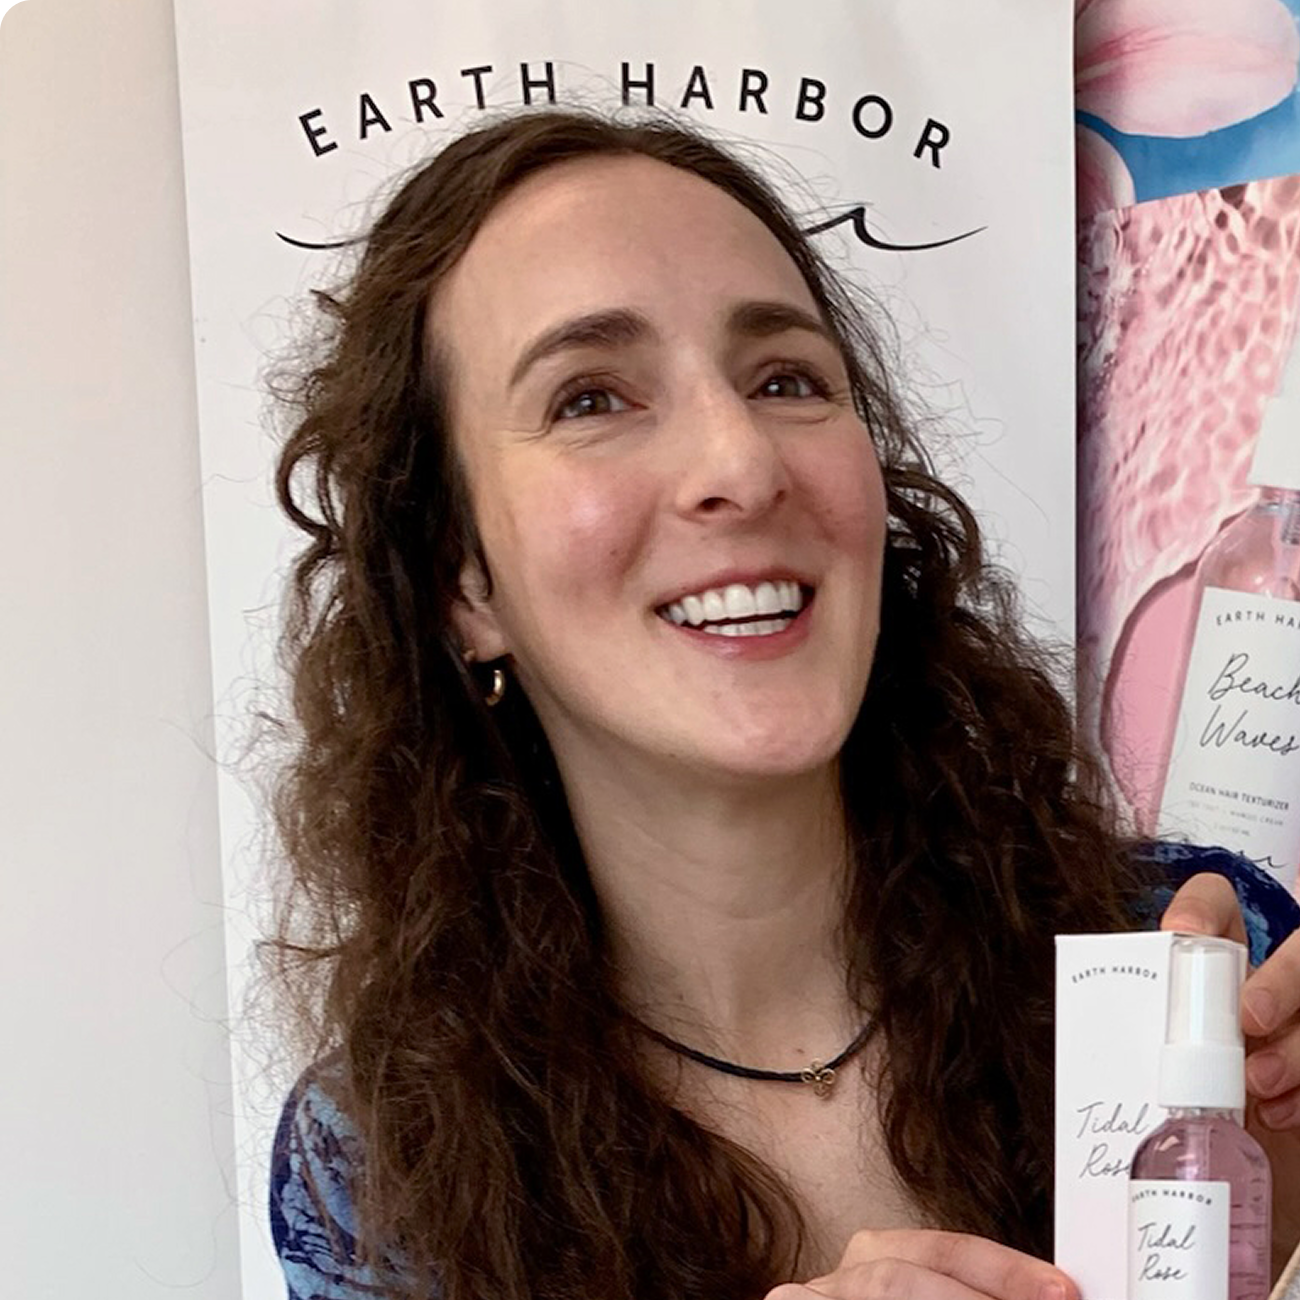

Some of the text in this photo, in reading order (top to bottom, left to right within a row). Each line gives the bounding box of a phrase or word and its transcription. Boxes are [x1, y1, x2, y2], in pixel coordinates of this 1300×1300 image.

[297, 61, 954, 169] EARTH HARBOR
[1216, 609, 1267, 627] EARTH
[1199, 704, 1300, 757] Waves
[1218, 789, 1239, 800] HAIR
[1241, 792, 1290, 811] TEXTURIZER
[1072, 965, 1158, 984] EARTH HARBOR
[1077, 1101, 1150, 1139] Tidal
[1163, 1188, 1214, 1207] HARBOR
[1137, 1221, 1197, 1253] Tidal
[1137, 1253, 1189, 1282] Rose
